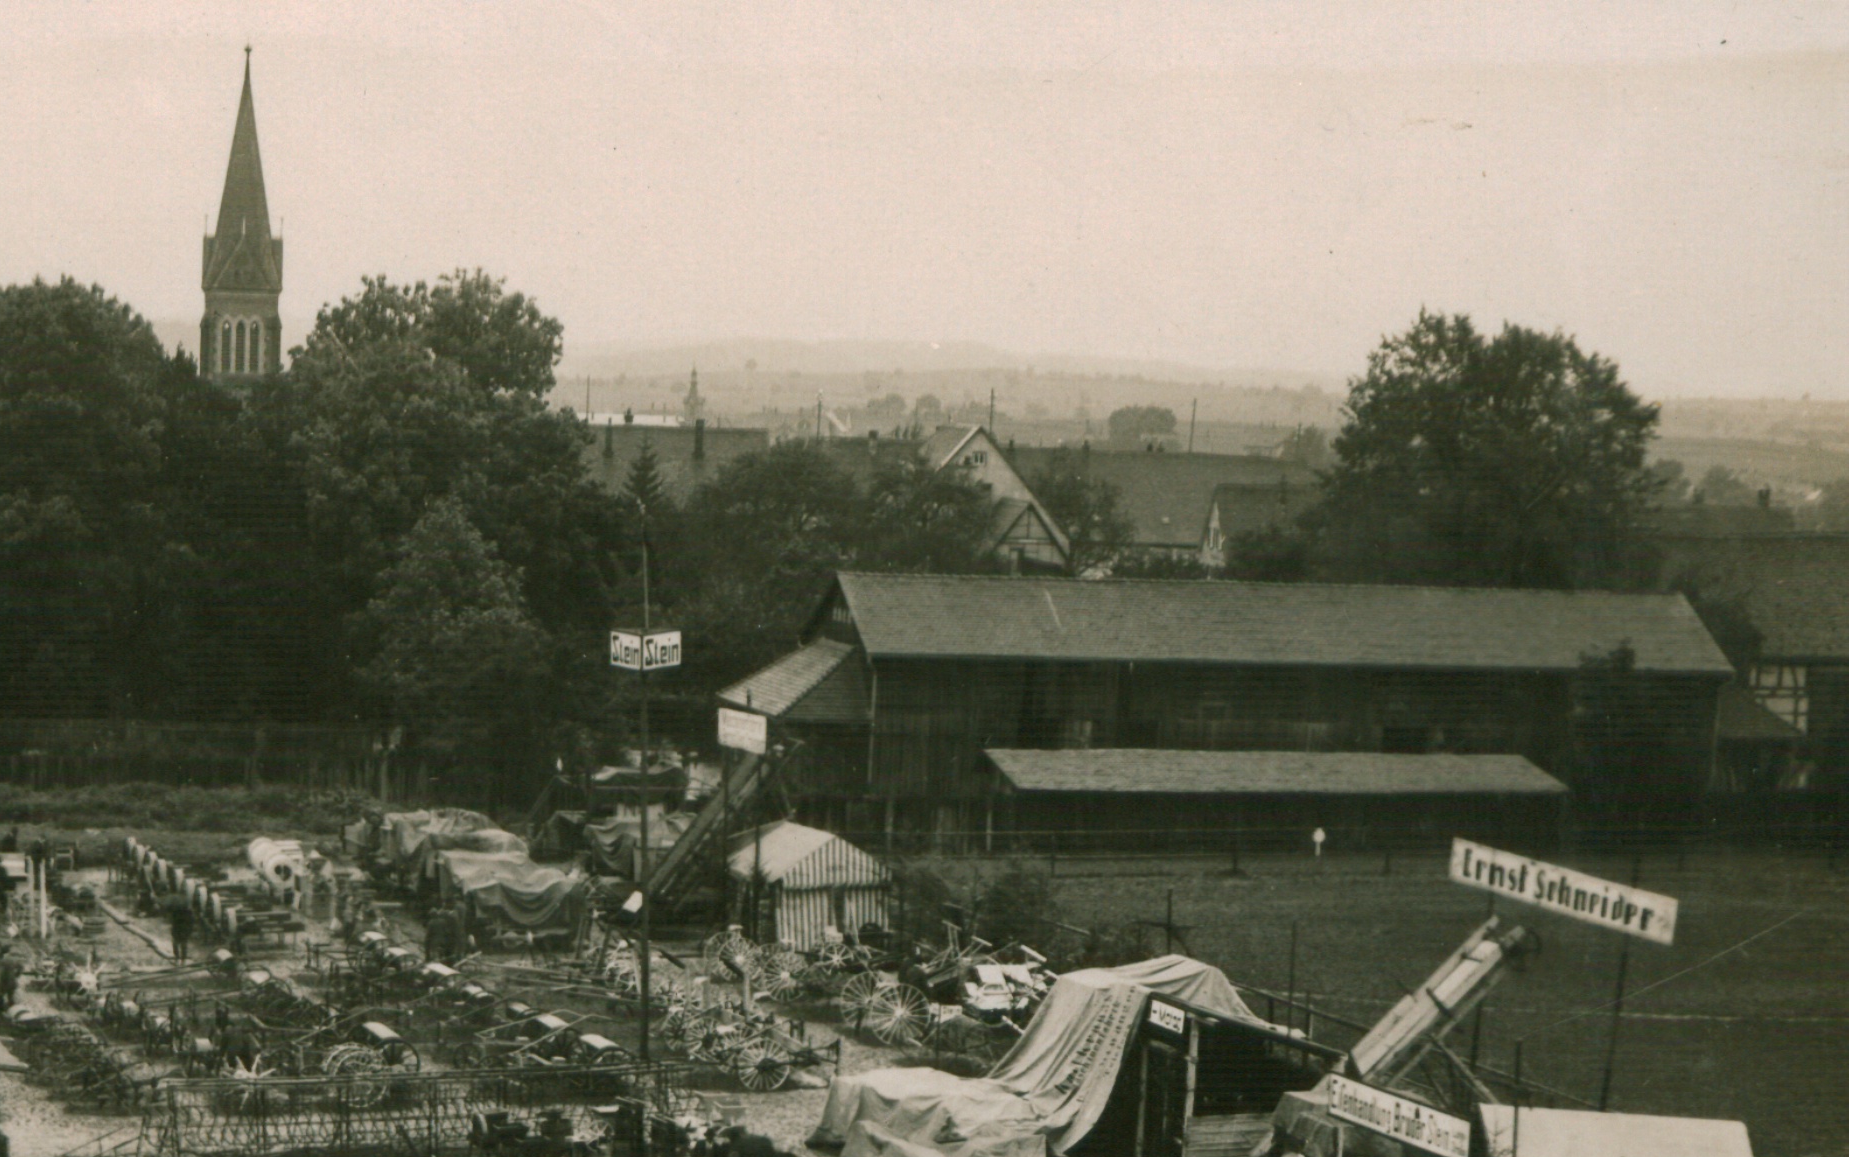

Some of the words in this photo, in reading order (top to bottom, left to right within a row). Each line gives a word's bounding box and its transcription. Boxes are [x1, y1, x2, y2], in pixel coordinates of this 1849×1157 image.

[612, 635, 640, 665] Stein
[644, 637, 679, 666] Stein
[1463, 847, 1528, 893] Ernst
[1534, 869, 1654, 931] Schneider
